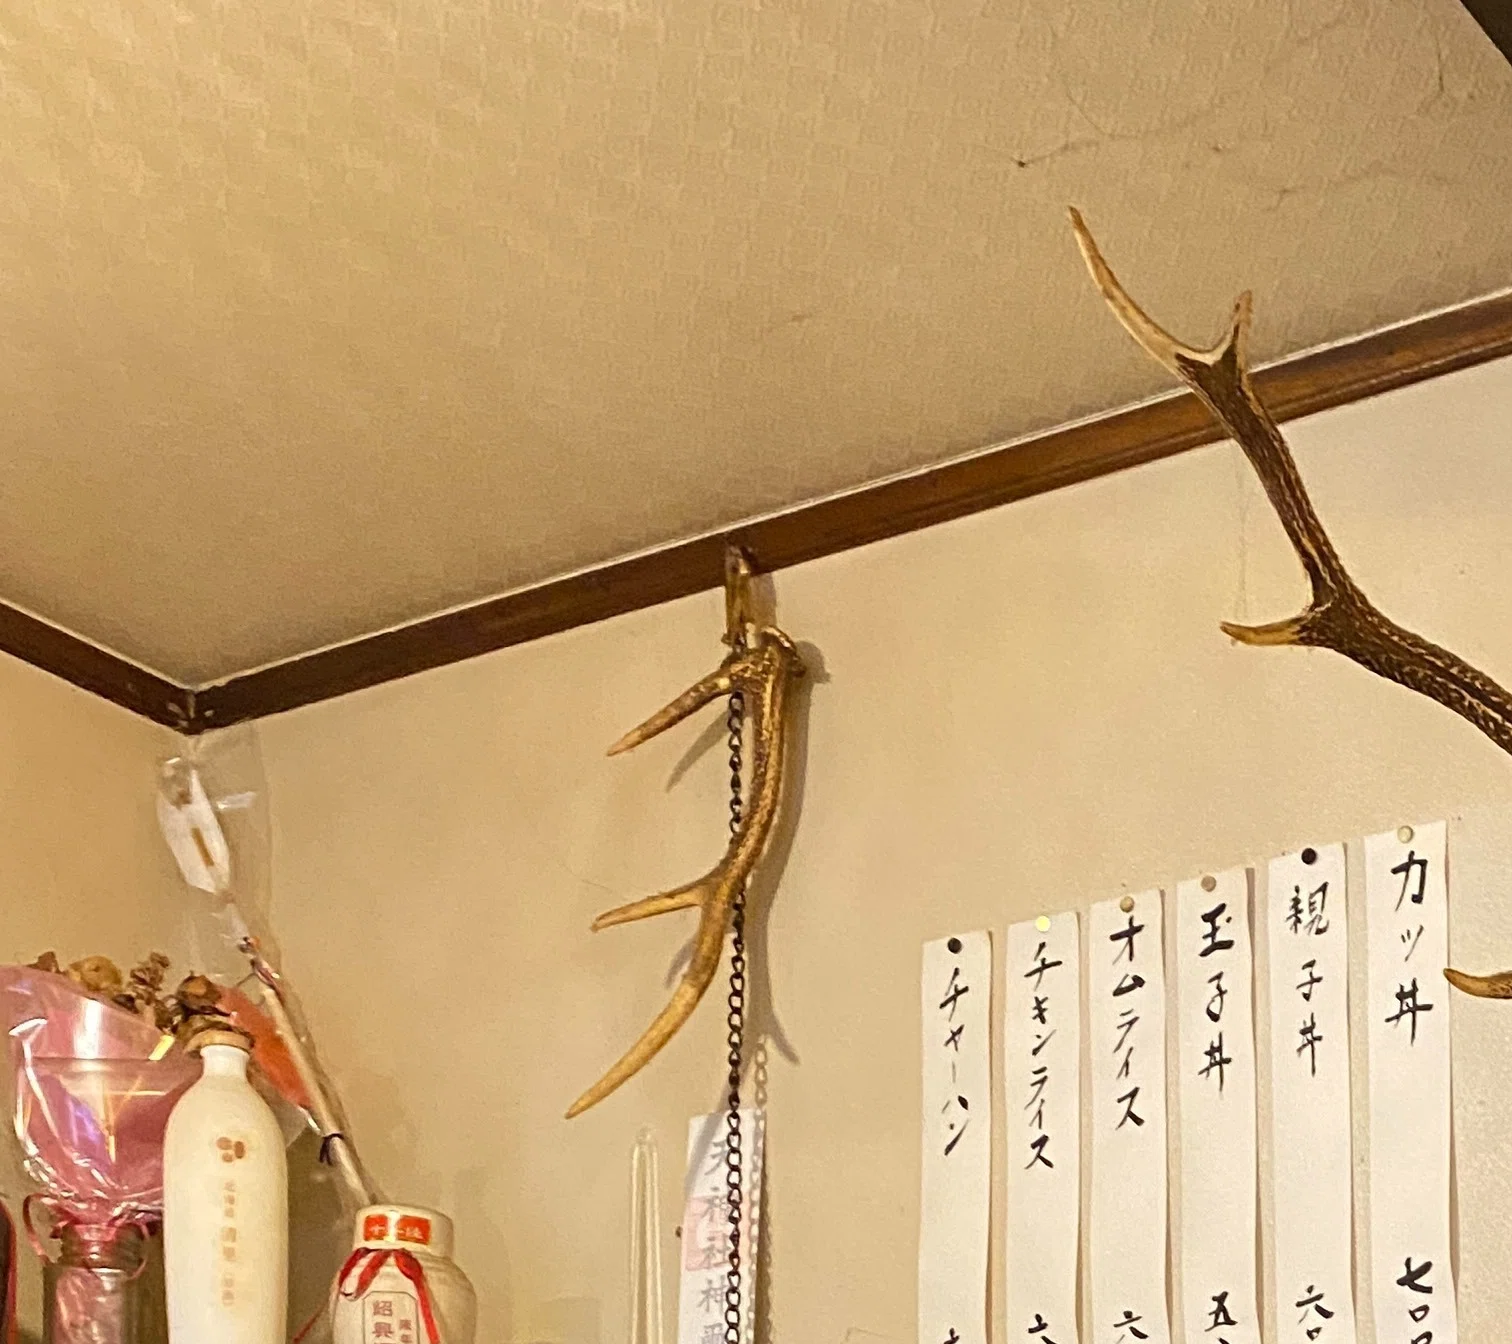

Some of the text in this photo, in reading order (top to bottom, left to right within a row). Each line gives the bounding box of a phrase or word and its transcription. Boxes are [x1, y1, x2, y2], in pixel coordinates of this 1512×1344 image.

[939, 966, 969, 1156] チャーハン
[1024, 941, 1063, 1170] チキンライス
[1109, 915, 1146, 1130] オムライス
